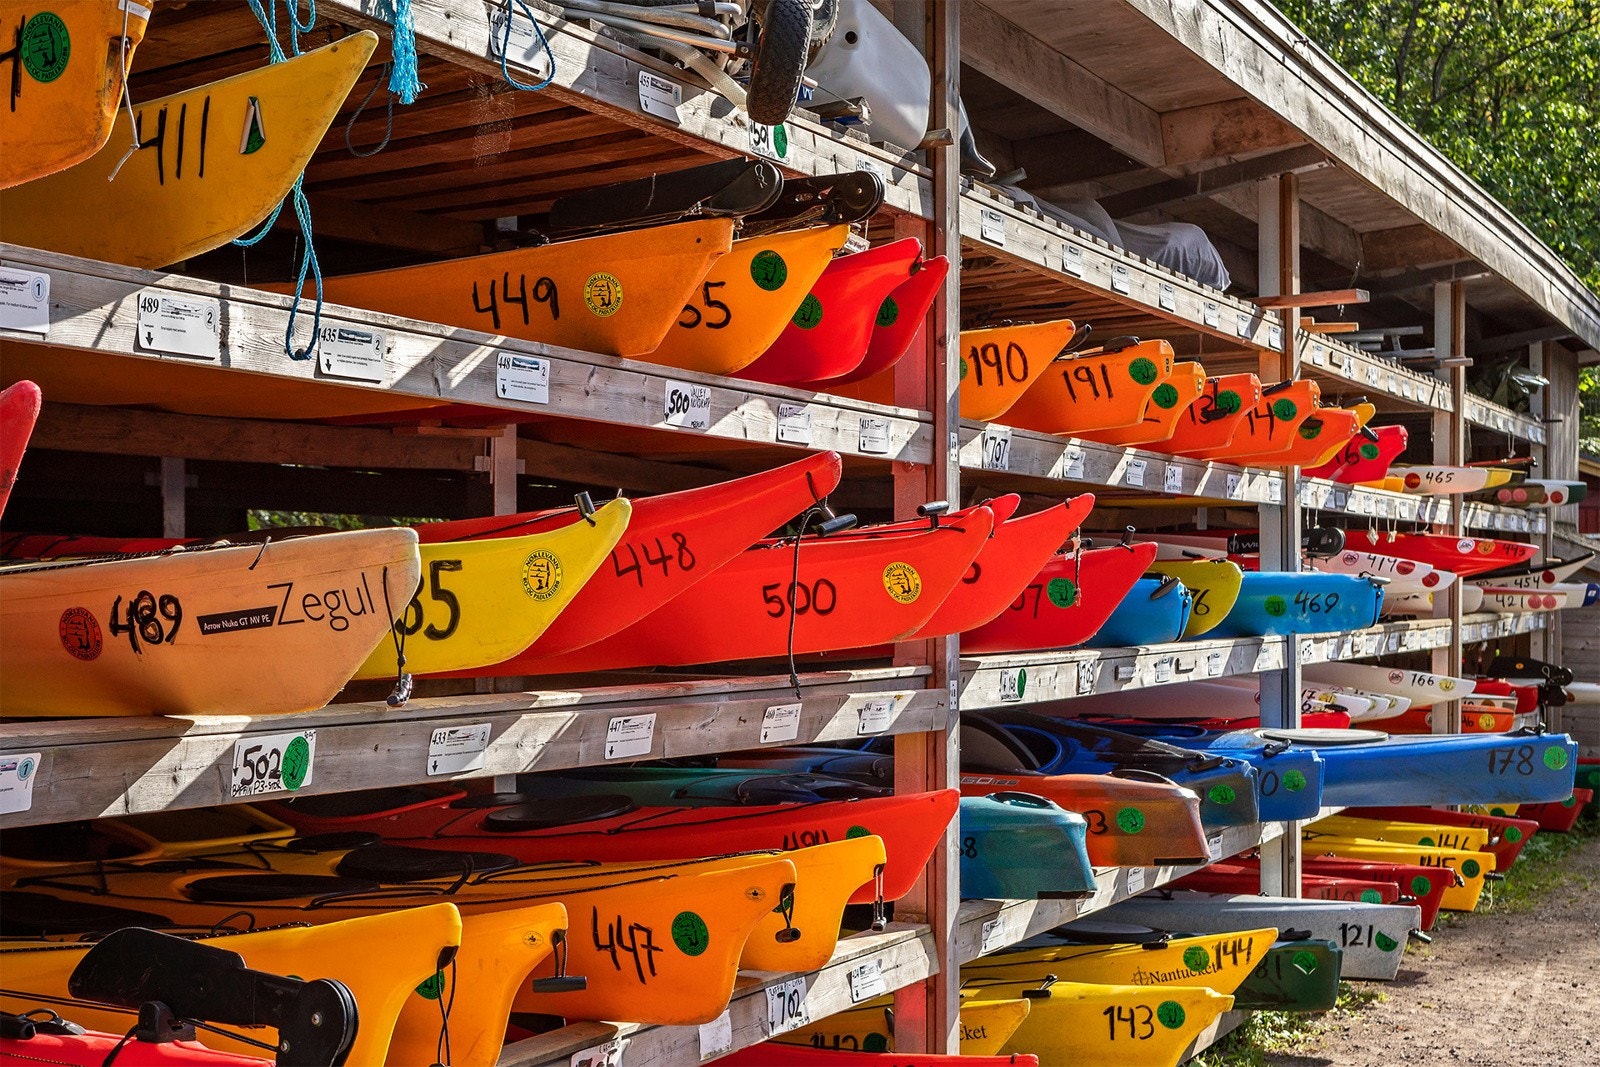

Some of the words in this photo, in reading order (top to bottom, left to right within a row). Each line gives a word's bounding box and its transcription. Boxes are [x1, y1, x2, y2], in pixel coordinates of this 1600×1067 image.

[36, 283, 41, 296] 1
[472, 272, 560, 329] 449
[141, 297, 159, 314] 489
[207, 311, 213, 324] 2
[321, 327, 337, 343] 435
[375, 339, 380, 351] 2
[498, 356, 511, 370] 448
[968, 341, 1028, 387] 190
[1061, 362, 1113, 404] 191
[668, 389, 690, 415] 500
[1425, 471, 1455, 485] 465
[525, 551, 560, 569] NØKLEVANN
[612, 532, 696, 588] 448
[1514, 575, 1541, 589] 454
[267, 572, 375, 631] Zegul
[762, 578, 837, 619] 500
[1294, 589, 1340, 614] 469
[1495, 594, 1524, 609] 421
[109, 590, 182, 656] 489
[204, 622, 221, 631] Arrow
[239, 617, 249, 627] GT
[250, 615, 261, 625] MV
[262, 614, 271, 624] PE
[432, 731, 447, 745] 433
[610, 720, 622, 732] 447
[23, 763, 29, 776] 1
[240, 744, 282, 786] 502
[1487, 745, 1535, 777] 178
[592, 906, 664, 985] 447
[1339, 922, 1373, 949] 121
[1213, 937, 1254, 971] 144
[777, 988, 803, 1025] 702
[1104, 1004, 1155, 1042] 143
